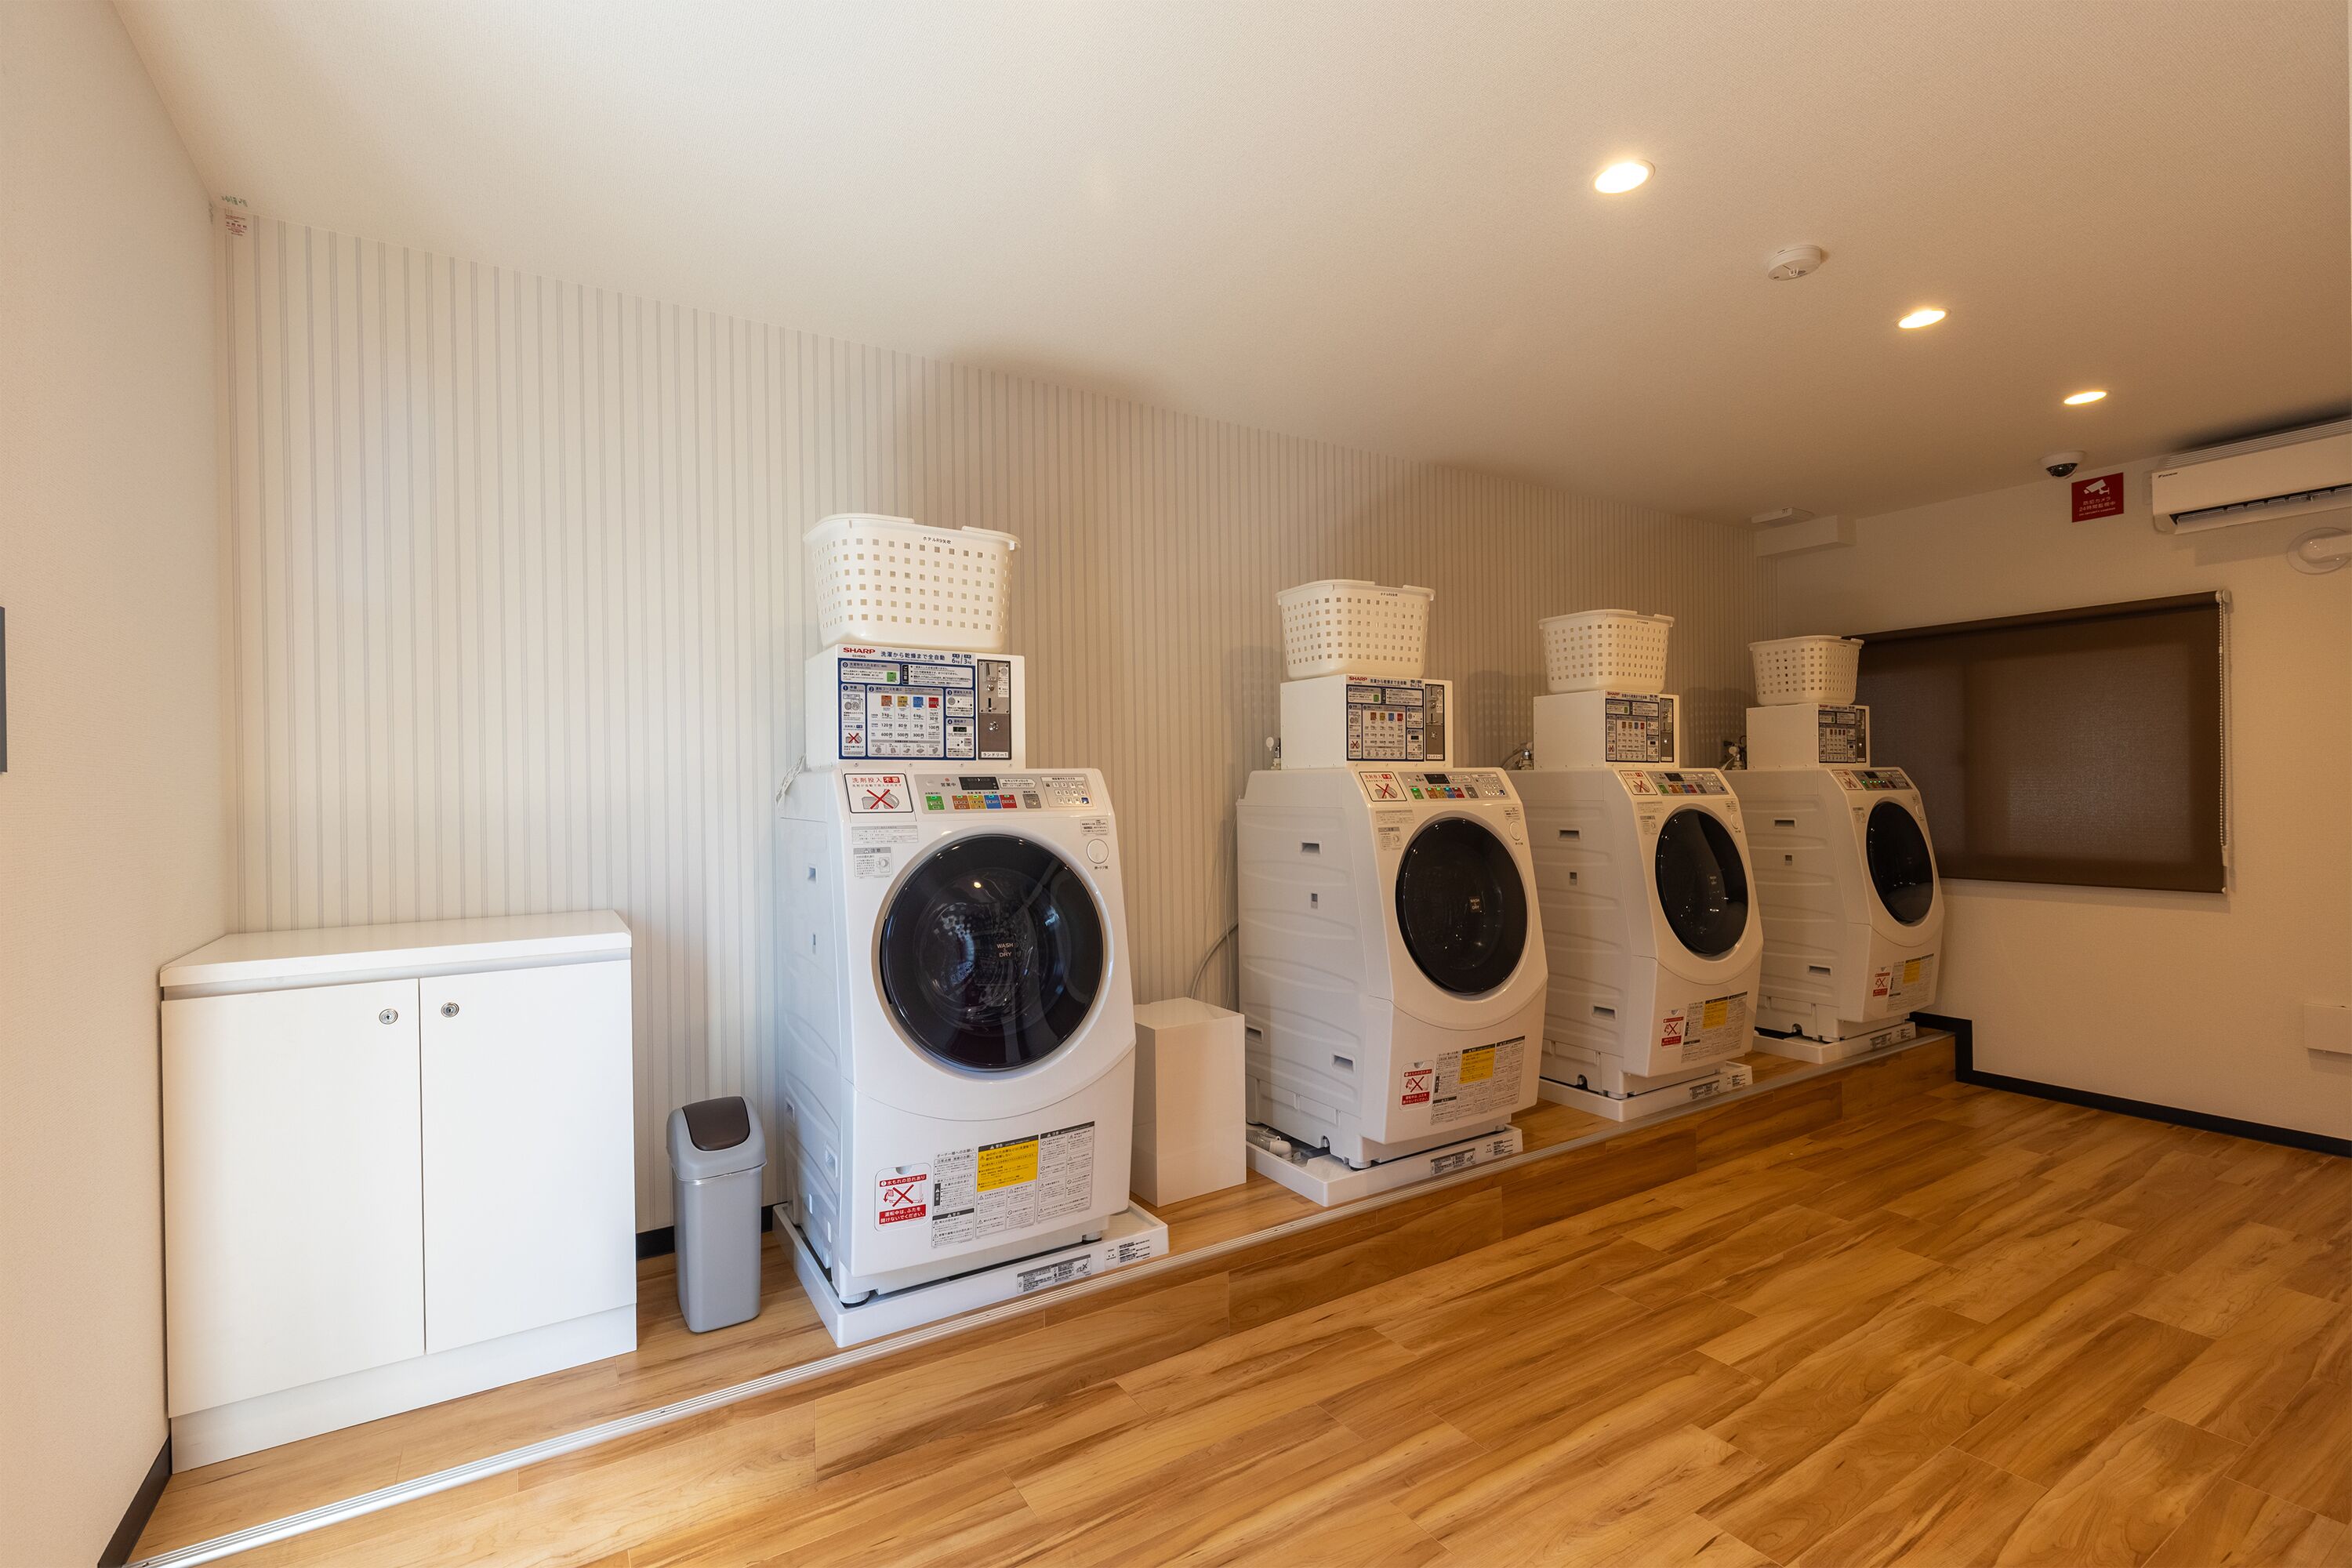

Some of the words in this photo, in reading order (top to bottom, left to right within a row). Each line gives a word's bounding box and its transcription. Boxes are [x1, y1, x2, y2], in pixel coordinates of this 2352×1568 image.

[2083, 496, 2111, 506] 防犯カメラ
[2079, 501, 2115, 512] 24時間監視中
[880, 651, 945, 661] 洗濯から乾燥まで全自動
[887, 1176, 925, 1185] 水もれの恐れあり
[885, 1207, 921, 1217] 運転中は、ふたを
[880, 1212, 924, 1223] 開けないでください。
